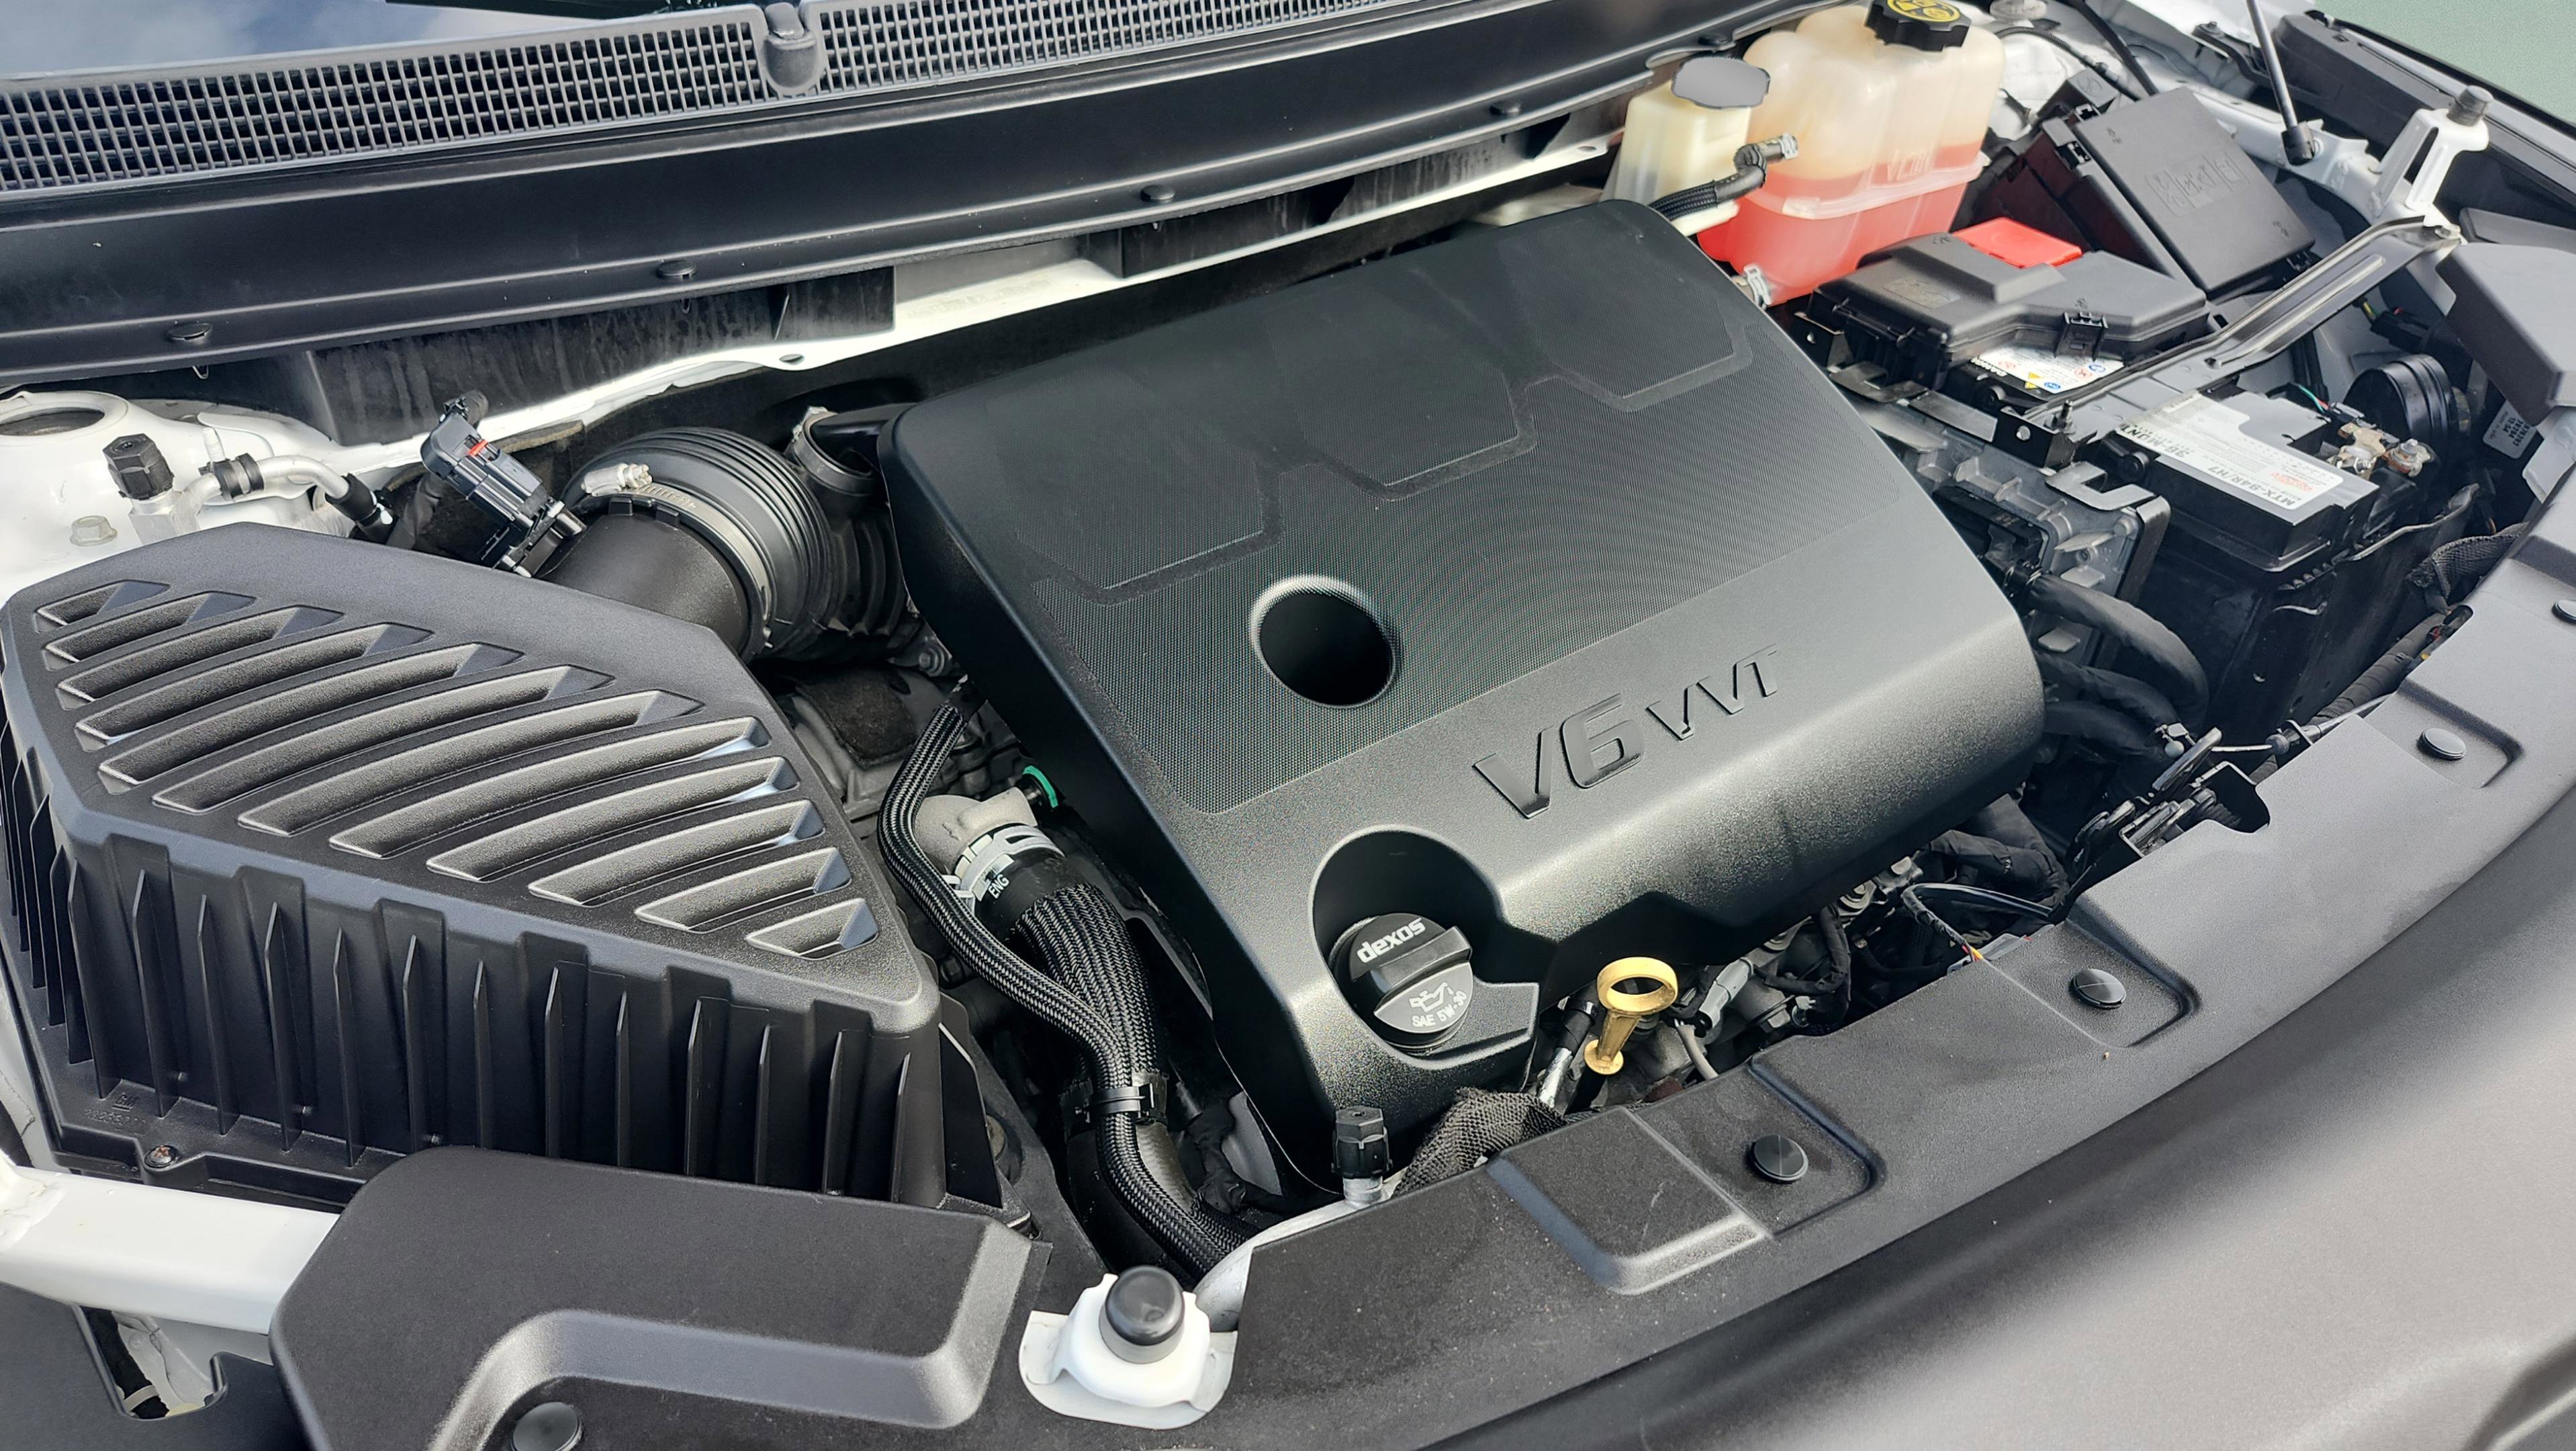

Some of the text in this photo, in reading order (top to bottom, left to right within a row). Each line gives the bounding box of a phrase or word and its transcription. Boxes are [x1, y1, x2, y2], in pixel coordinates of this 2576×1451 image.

[2118, 423, 2191, 459] 36-MONT
[1472, 643, 1778, 819] V6 VVT
[987, 873, 1010, 899] ENG
[1356, 917, 1426, 963] dexos
[1412, 991, 1467, 1027] SAE 5W-30
